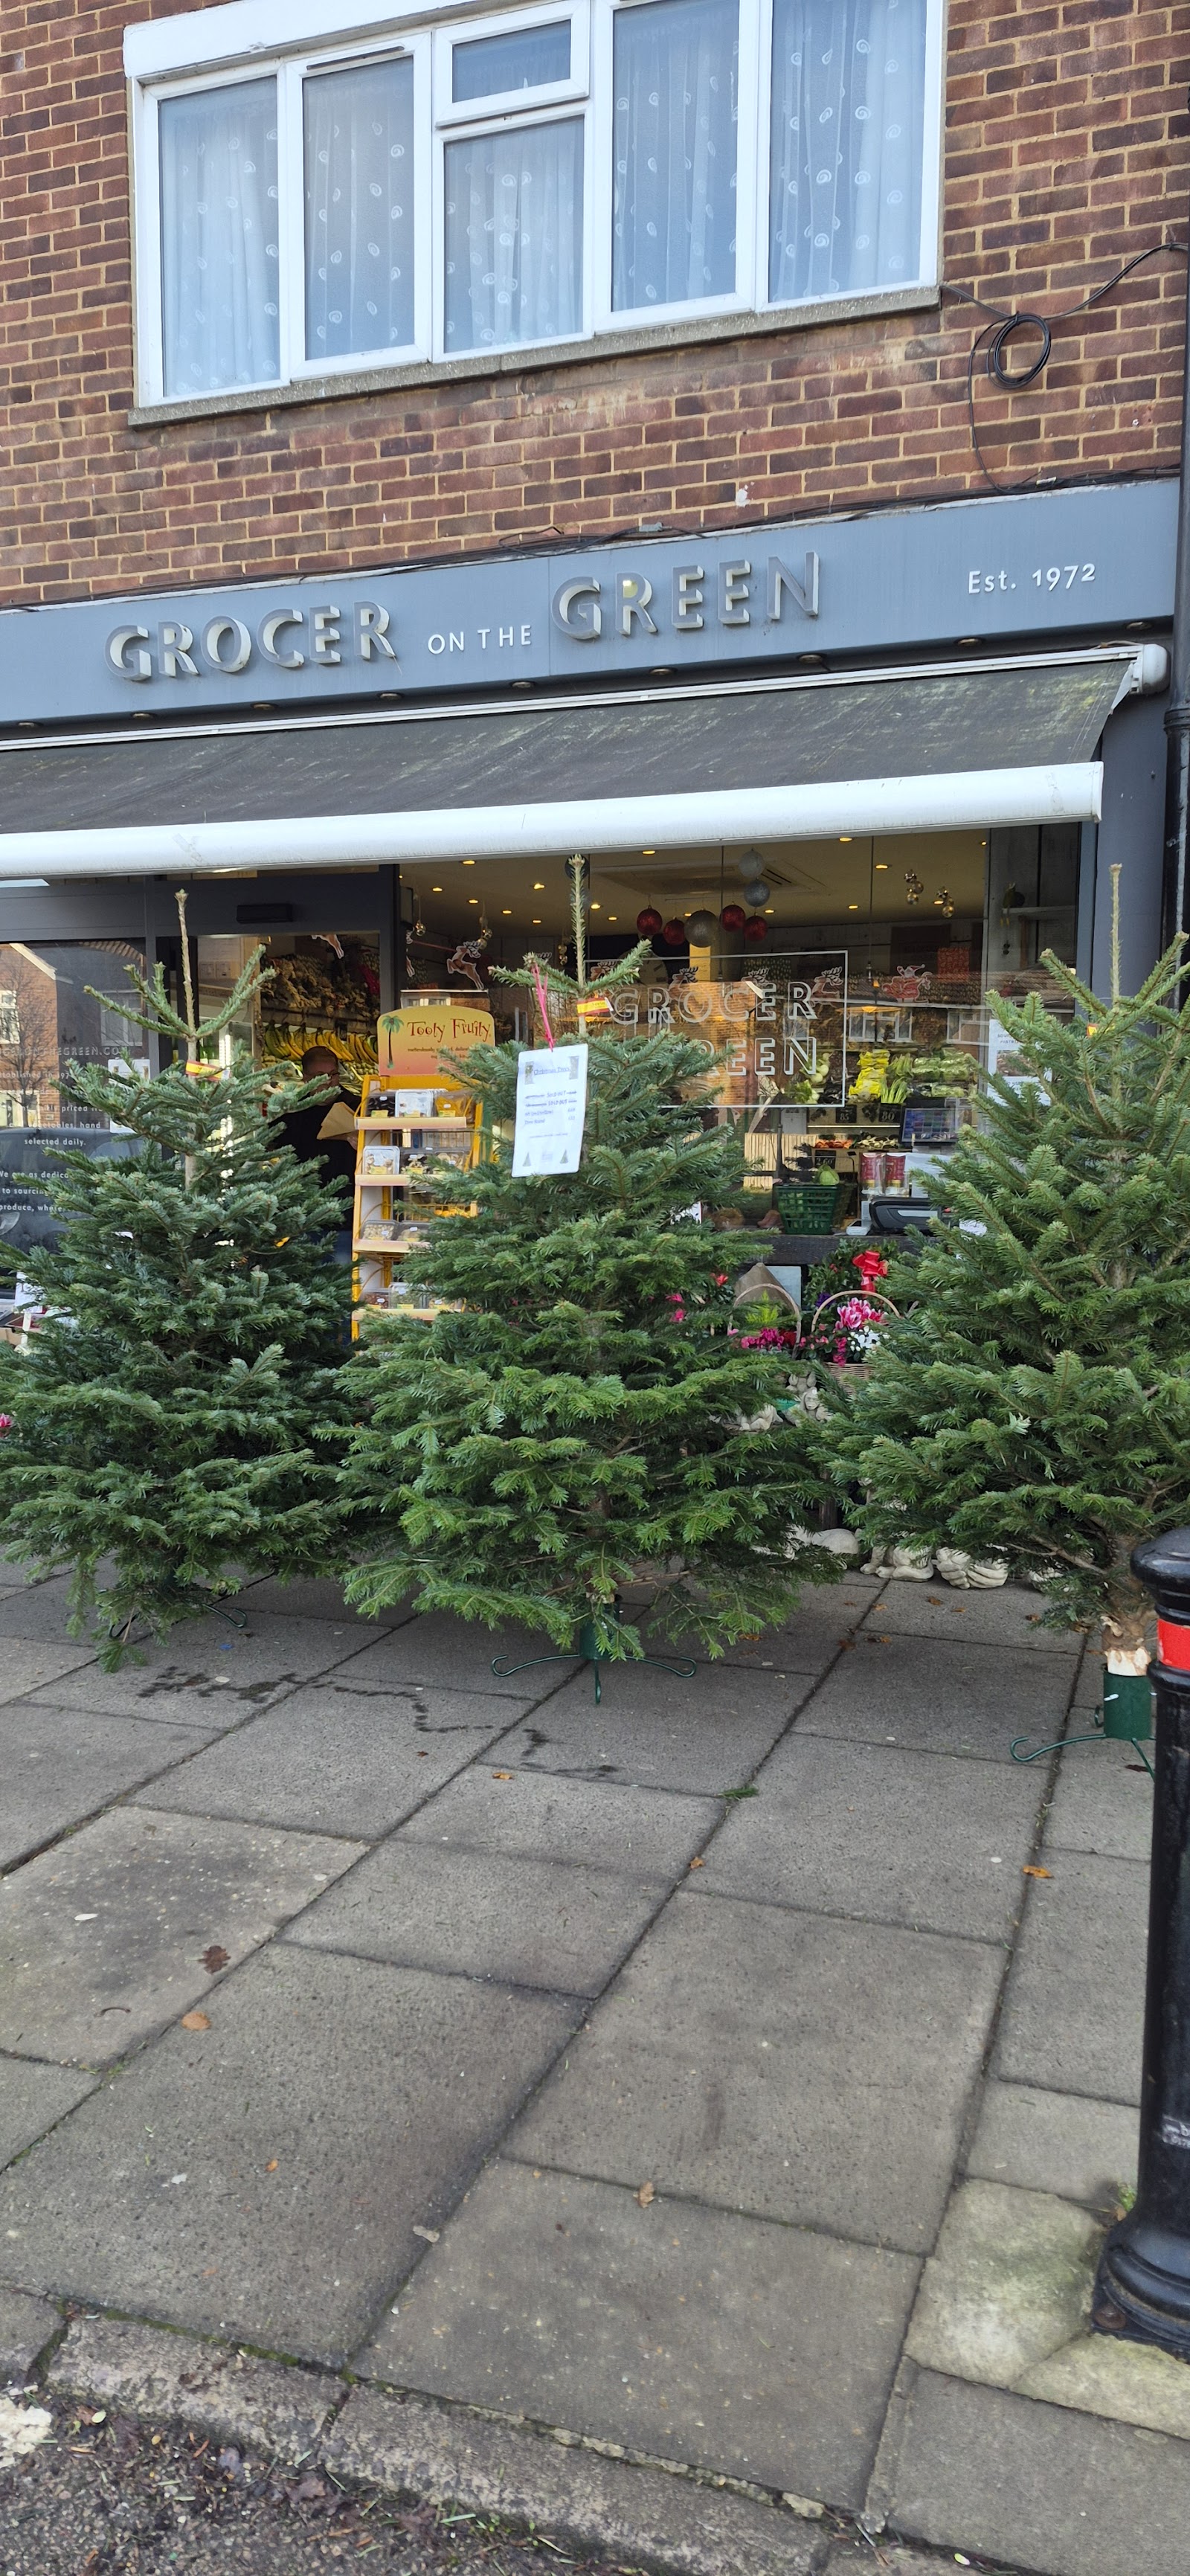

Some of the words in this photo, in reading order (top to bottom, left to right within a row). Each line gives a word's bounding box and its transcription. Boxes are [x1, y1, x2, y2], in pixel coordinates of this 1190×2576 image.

[968, 570, 1017, 594] Est.
[1032, 562, 1096, 592] 1972
[104, 600, 396, 681] GROCER
[428, 632, 465, 655] ON
[478, 625, 532, 649] THE
[551, 551, 820, 640] GREEN
[611, 980, 817, 1026] GROCER
[80, 1121, 101, 1129] hand
[25, 1137, 60, 1146] selected
[62, 1137, 86, 1147] daily.
[41, 1171, 69, 1179] dedica
